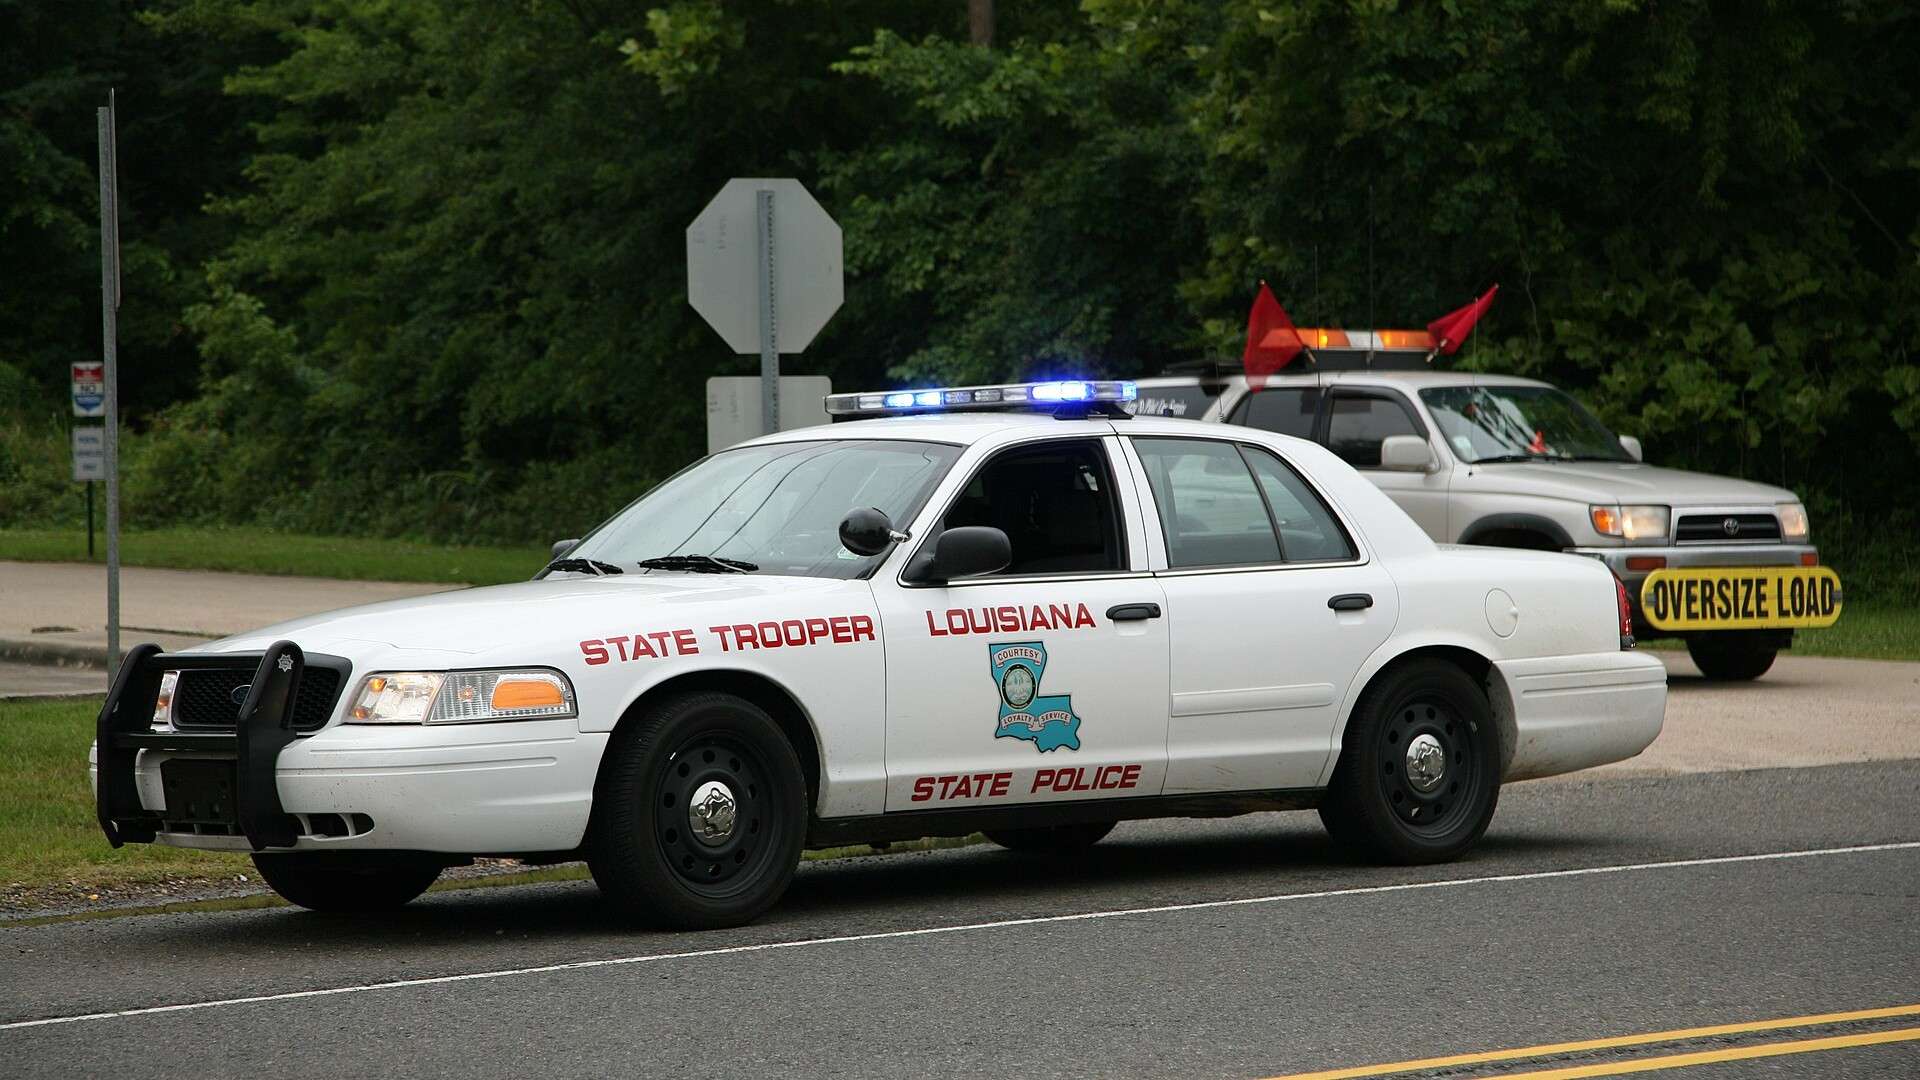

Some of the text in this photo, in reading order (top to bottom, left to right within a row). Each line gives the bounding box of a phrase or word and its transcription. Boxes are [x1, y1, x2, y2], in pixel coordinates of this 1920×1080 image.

[1653, 576, 1835, 621] OVERSIZE LOAD
[927, 604, 1096, 637] LOUISIANA
[579, 615, 875, 666] STATE TROOPER
[997, 648, 1040, 661] COURTESY
[1002, 714, 1032, 725] LOYALTY
[1040, 711, 1070, 722] SERVICE
[912, 765, 1142, 803] STATE POLICE
